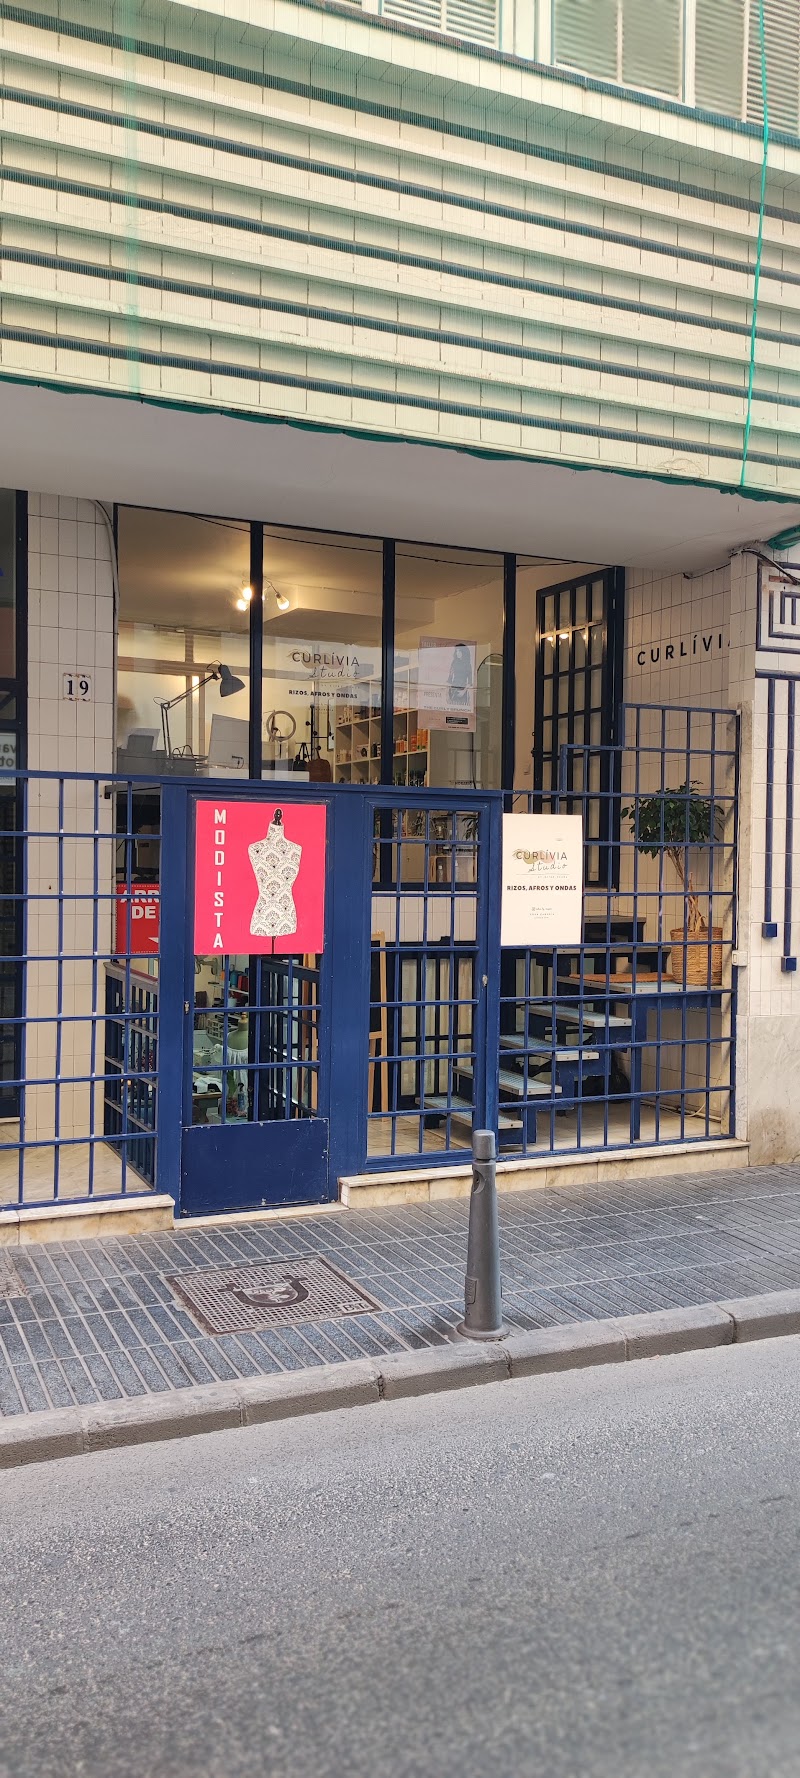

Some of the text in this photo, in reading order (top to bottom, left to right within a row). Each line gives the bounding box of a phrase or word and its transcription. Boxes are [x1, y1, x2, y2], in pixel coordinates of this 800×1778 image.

[637, 634, 730, 665] CURLÍVI
[66, 680, 89, 696] 19
[516, 849, 568, 860] CURLÍVIA
[212, 808, 227, 949] MODISTA
[120, 889, 159, 903] ARR
[131, 906, 157, 920] DE
